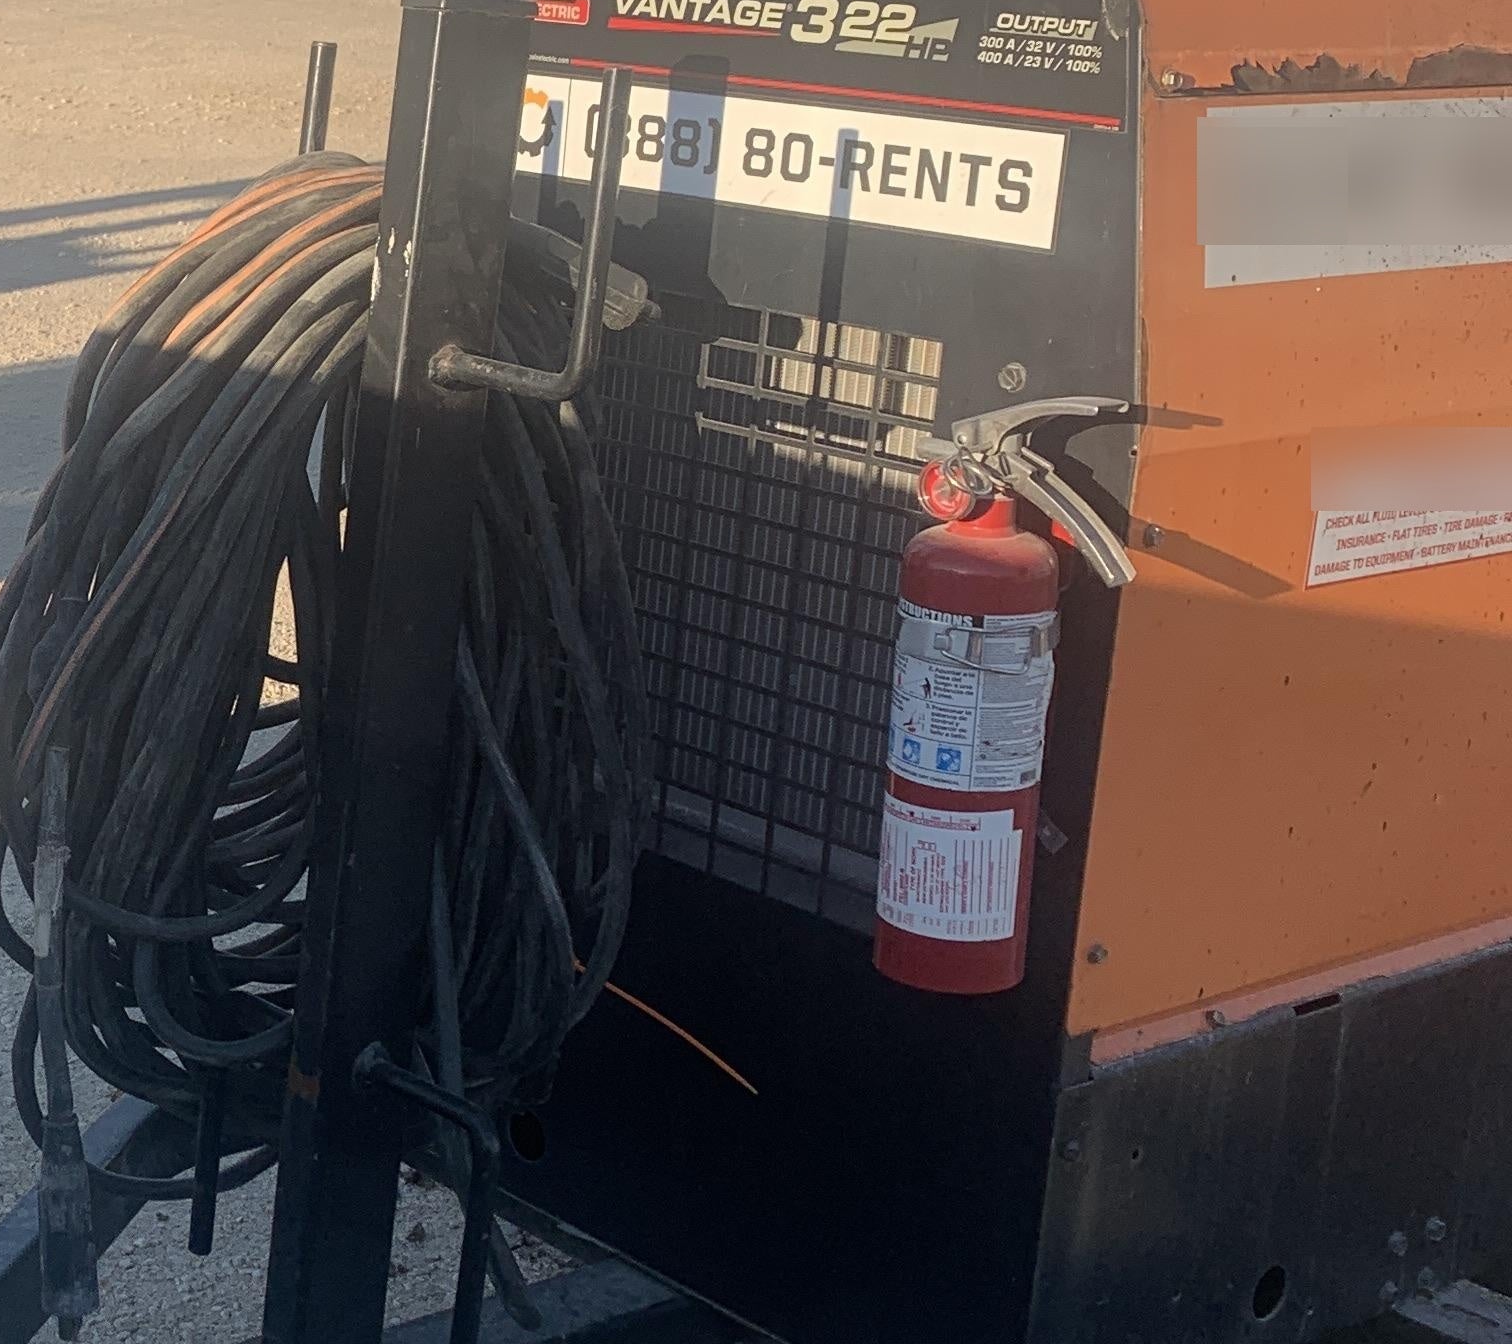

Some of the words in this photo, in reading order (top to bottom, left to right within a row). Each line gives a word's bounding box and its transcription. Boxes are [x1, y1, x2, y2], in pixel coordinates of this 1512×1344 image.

[538, 2, 581, 20] CTRIC
[996, 13, 1091, 35] OUTPUT
[979, 36, 1004, 49] 300
[1005, 39, 1016, 50] A
[1025, 40, 1043, 53] 32
[1046, 42, 1057, 54] V
[1067, 44, 1103, 58] 100%
[977, 51, 1002, 64] 400
[1003, 54, 1014, 65] A
[1023, 55, 1041, 68] 23
[1044, 57, 1055, 69] V
[1065, 59, 1101, 74] 100%
[584, 104, 722, 175] (88)
[742, 127, 1034, 214] 80-RENTS
[1325, 516, 1355, 531] CHECK
[1355, 513, 1370, 525] ALL
[1336, 532, 1387, 551] INSURANCE
[1392, 527, 1411, 541] FLAT
[1413, 523, 1438, 538] TIRES
[1444, 520, 1463, 533] TIRE
[1464, 514, 1499, 529] DAMAGE
[1314, 560, 1351, 576] DAMAGE
[1353, 558, 1364, 569] TO
[1365, 548, 1415, 568] EQUIPMENT
[1421, 541, 1458, 558] BATTERY
